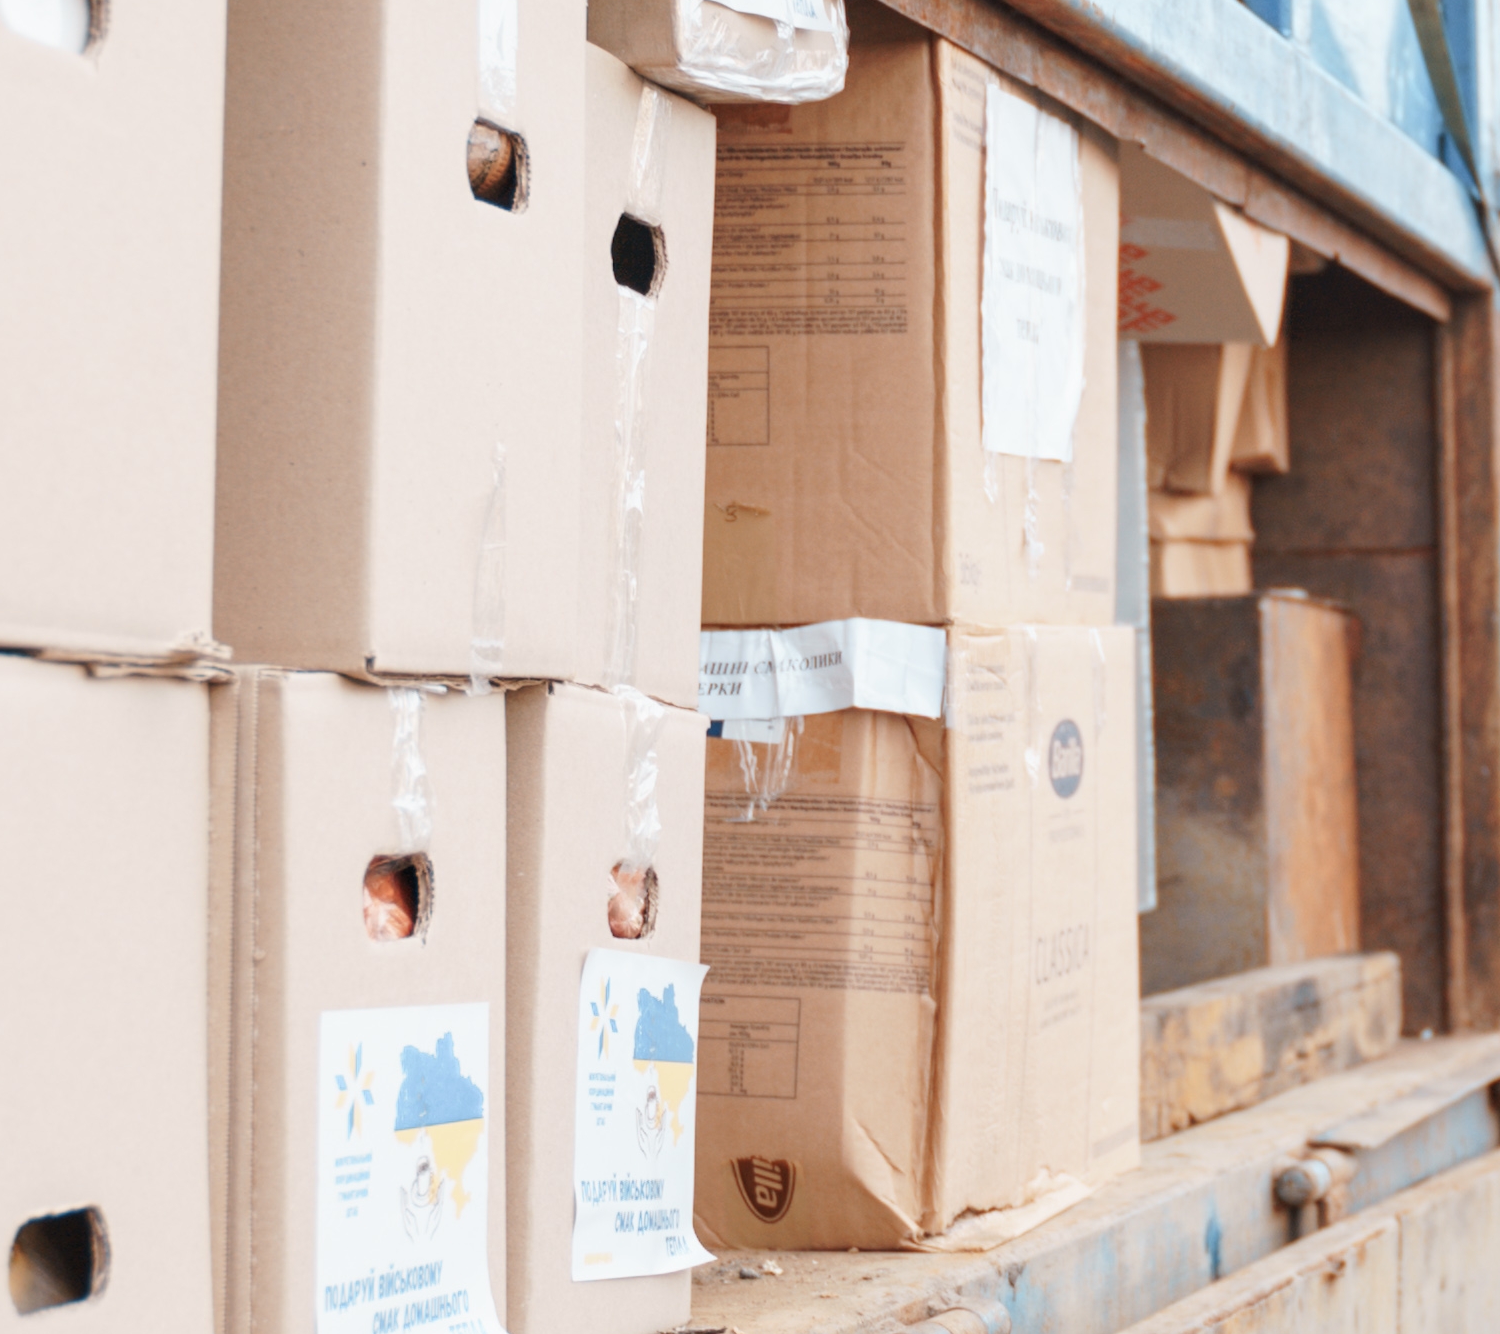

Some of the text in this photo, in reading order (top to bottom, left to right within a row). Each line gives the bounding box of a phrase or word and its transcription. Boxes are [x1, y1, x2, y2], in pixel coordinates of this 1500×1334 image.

[581, 1173, 665, 1207] ПОДАРУЙ ВІЙСЬКОВОМУ
[615, 1211, 635, 1233] СМАК
[637, 1208, 680, 1236] ДОМАШНЬОГО
[323, 1260, 443, 1313] ПОДАРУЙ ВІЙСЬКОВОМУ
[403, 1289, 469, 1334] ДОМАШНЬОГО
